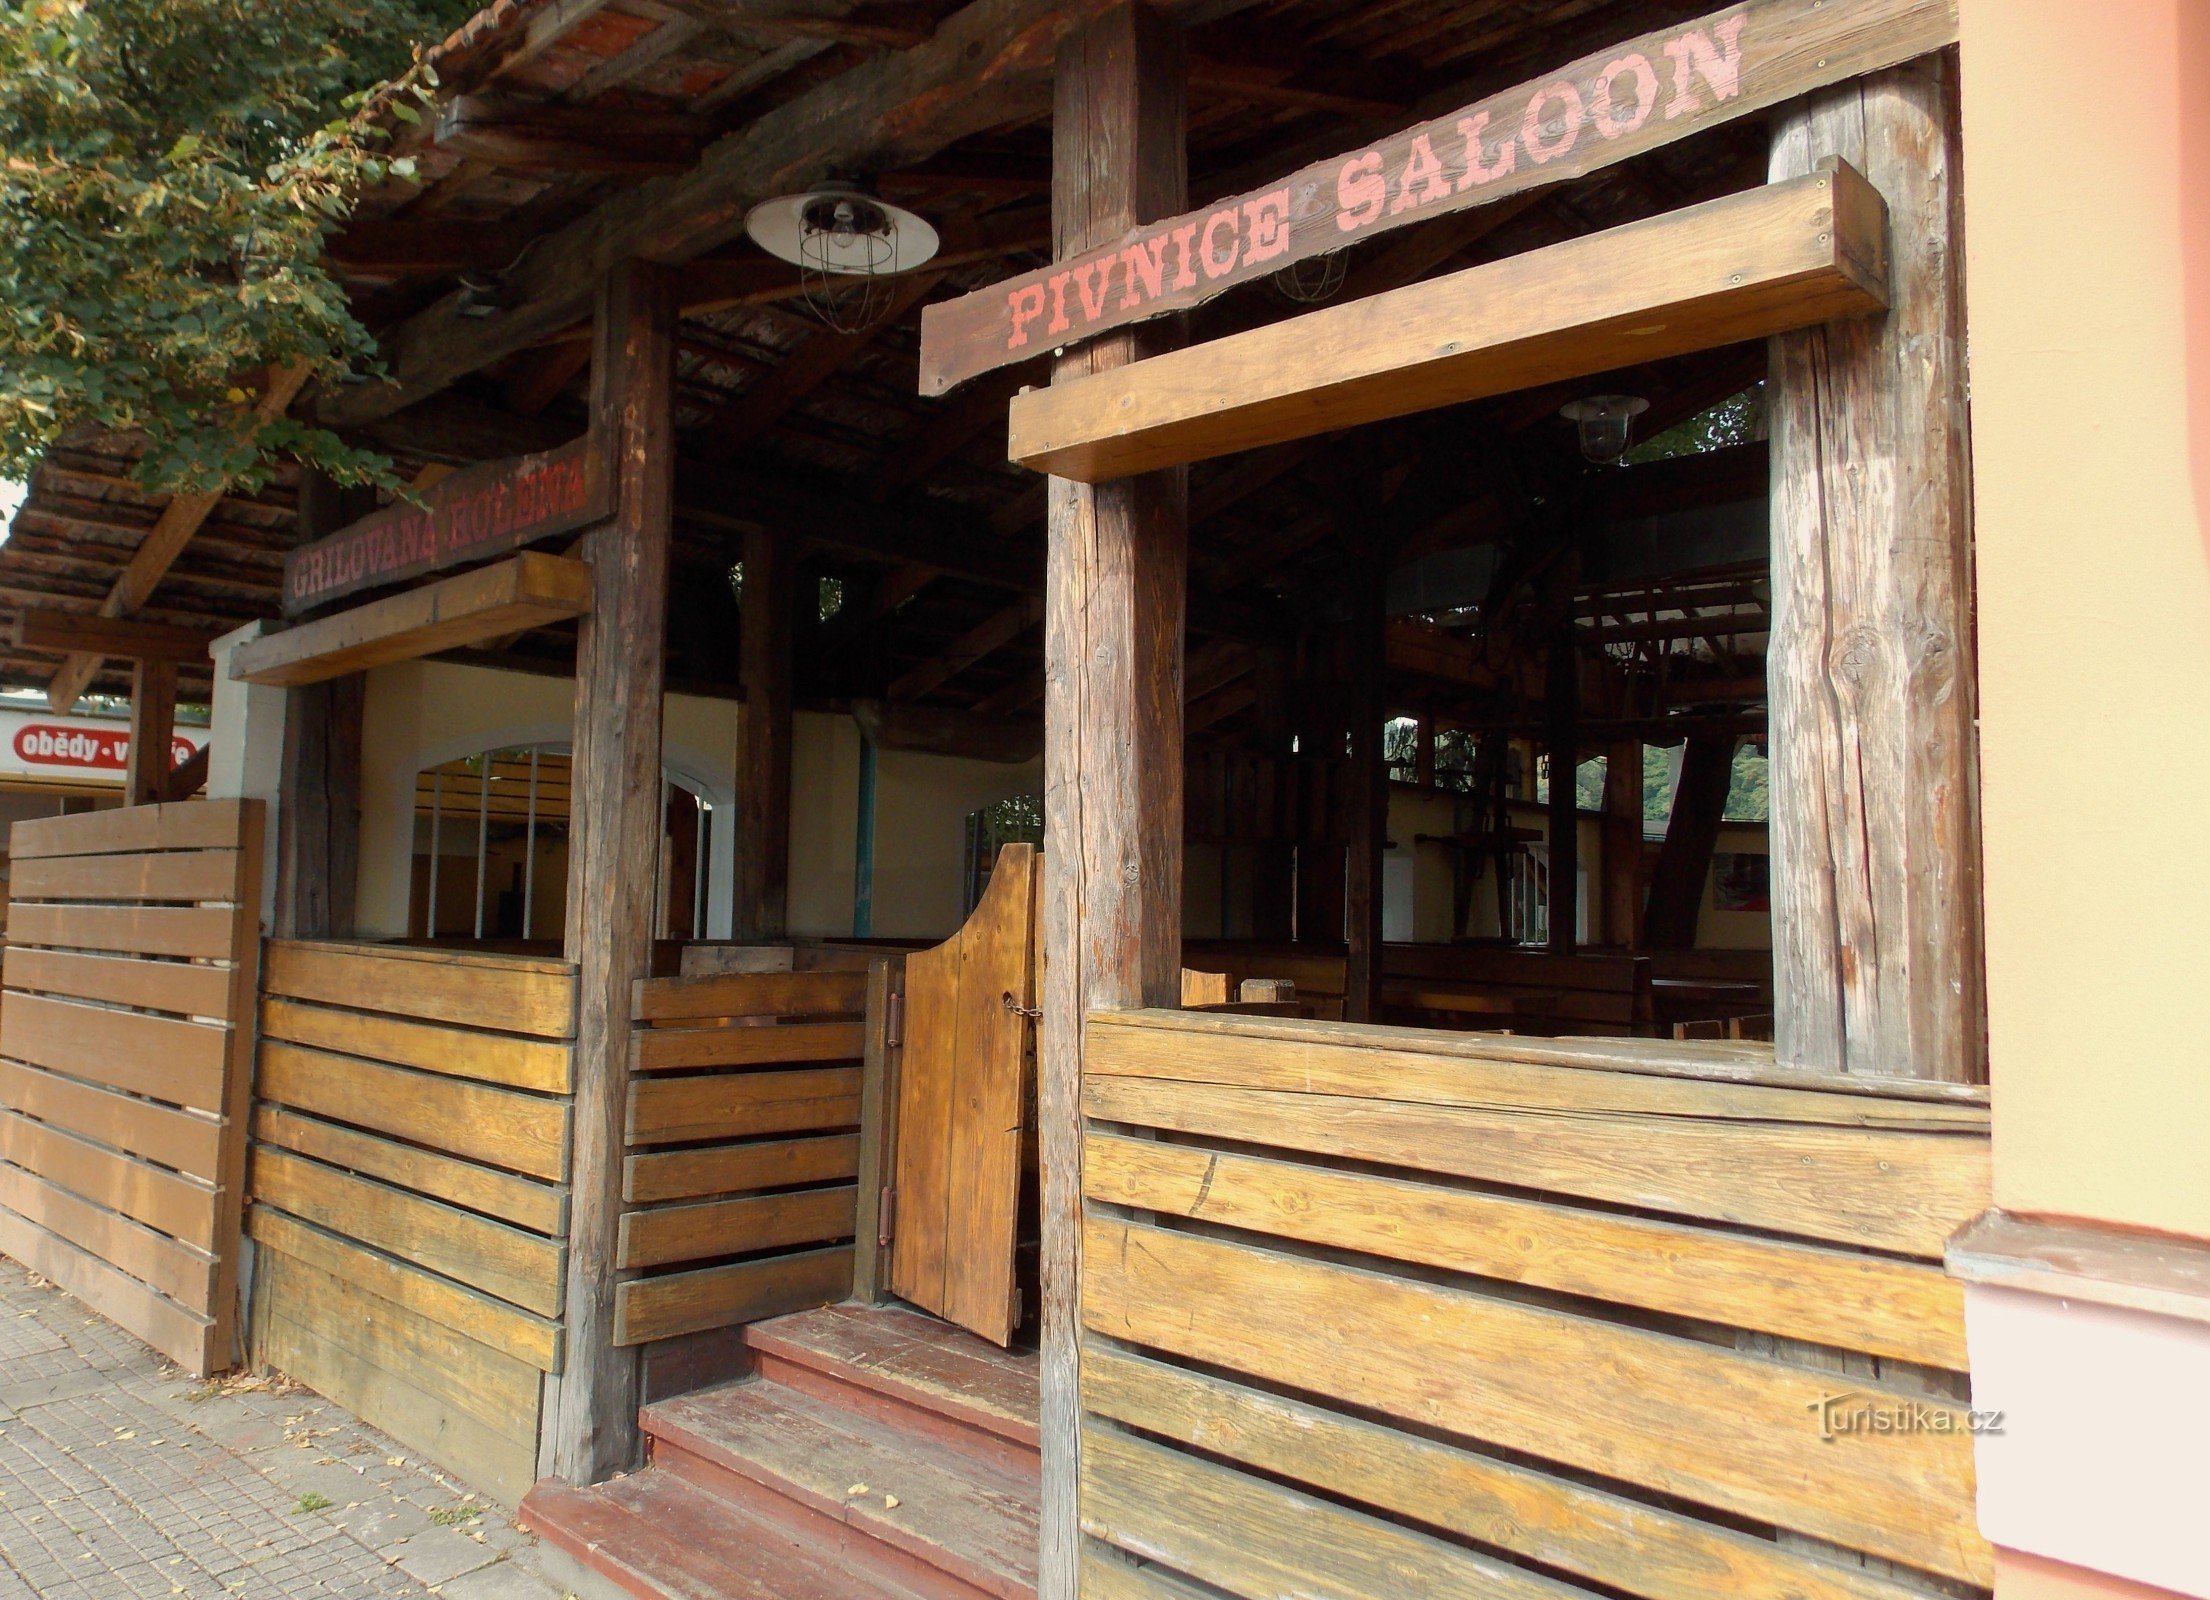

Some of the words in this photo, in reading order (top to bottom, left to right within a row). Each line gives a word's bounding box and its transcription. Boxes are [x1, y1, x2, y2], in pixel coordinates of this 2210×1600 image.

[1007, 188, 1291, 350] PIVNICE
[1336, 12, 1749, 233] SALOON
[22, 730, 100, 762] obědy
